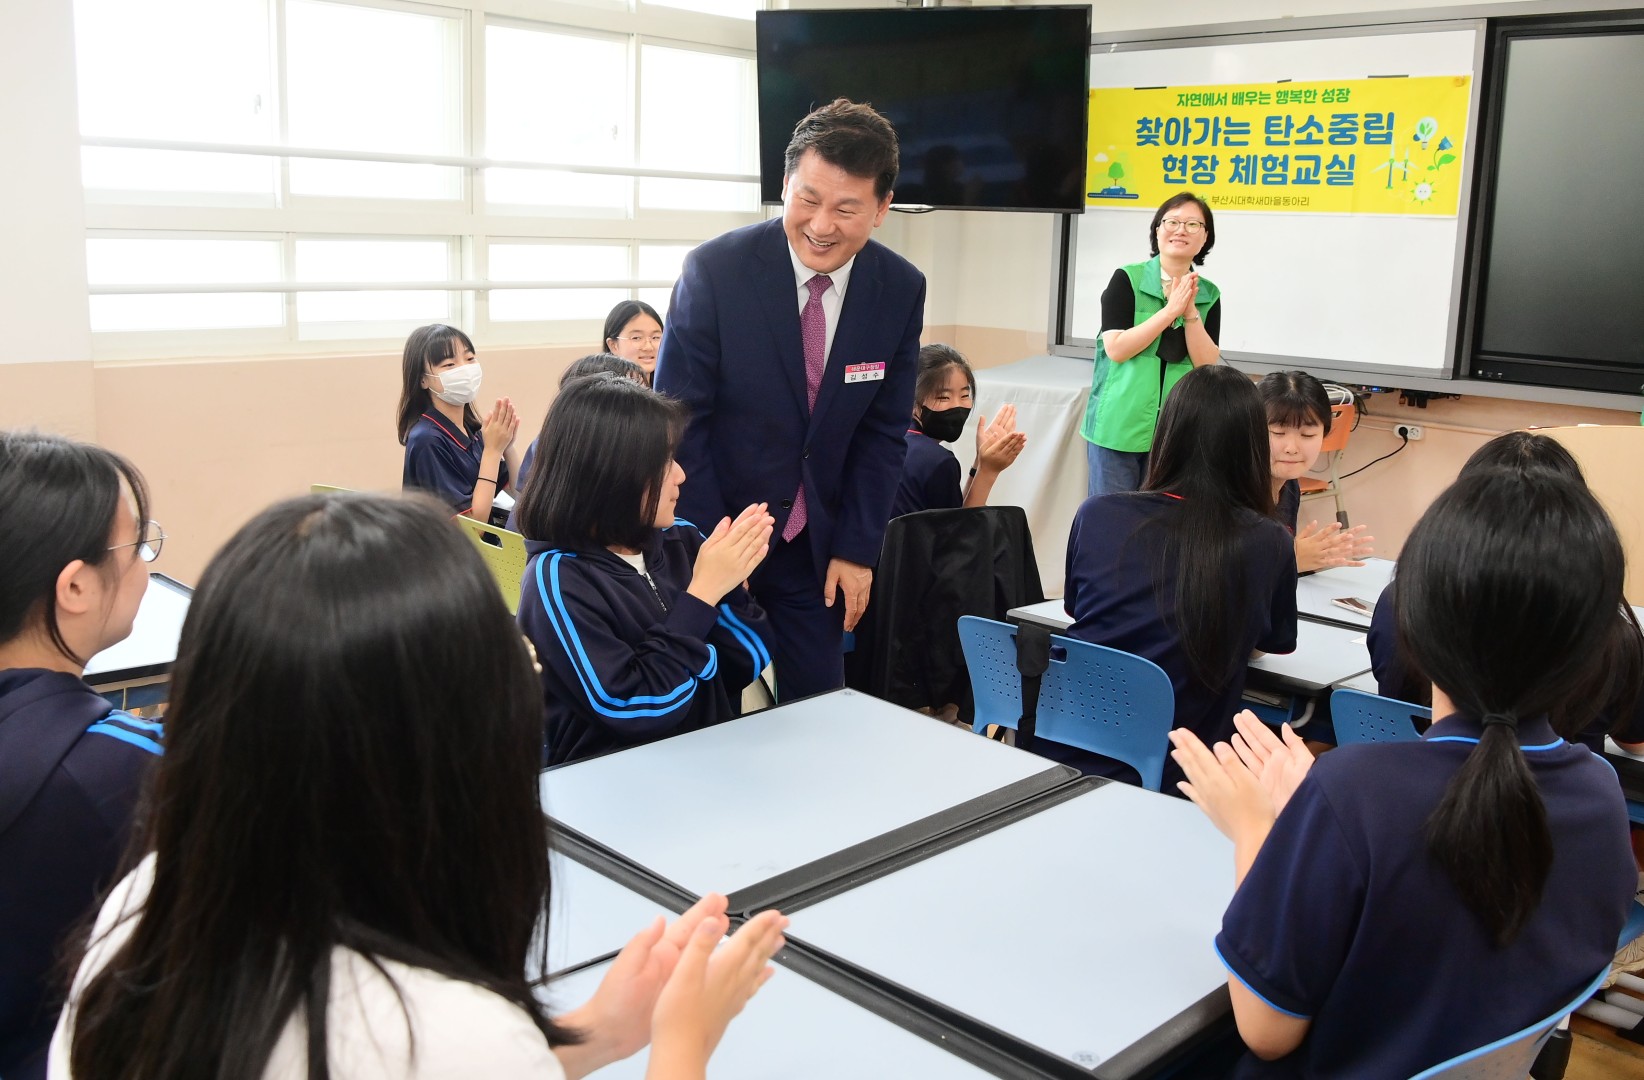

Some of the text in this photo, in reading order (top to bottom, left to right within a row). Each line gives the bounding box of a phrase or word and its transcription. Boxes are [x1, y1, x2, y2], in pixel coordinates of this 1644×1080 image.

[1176, 88, 1351, 107] 자연에서 배우는 행복한 성장
[1135, 112, 1395, 147] 찾아가는 탄소중립
[1161, 154, 1356, 186] 현장 체험교실
[1211, 195, 1310, 208] 부산시대학새마을동아리
